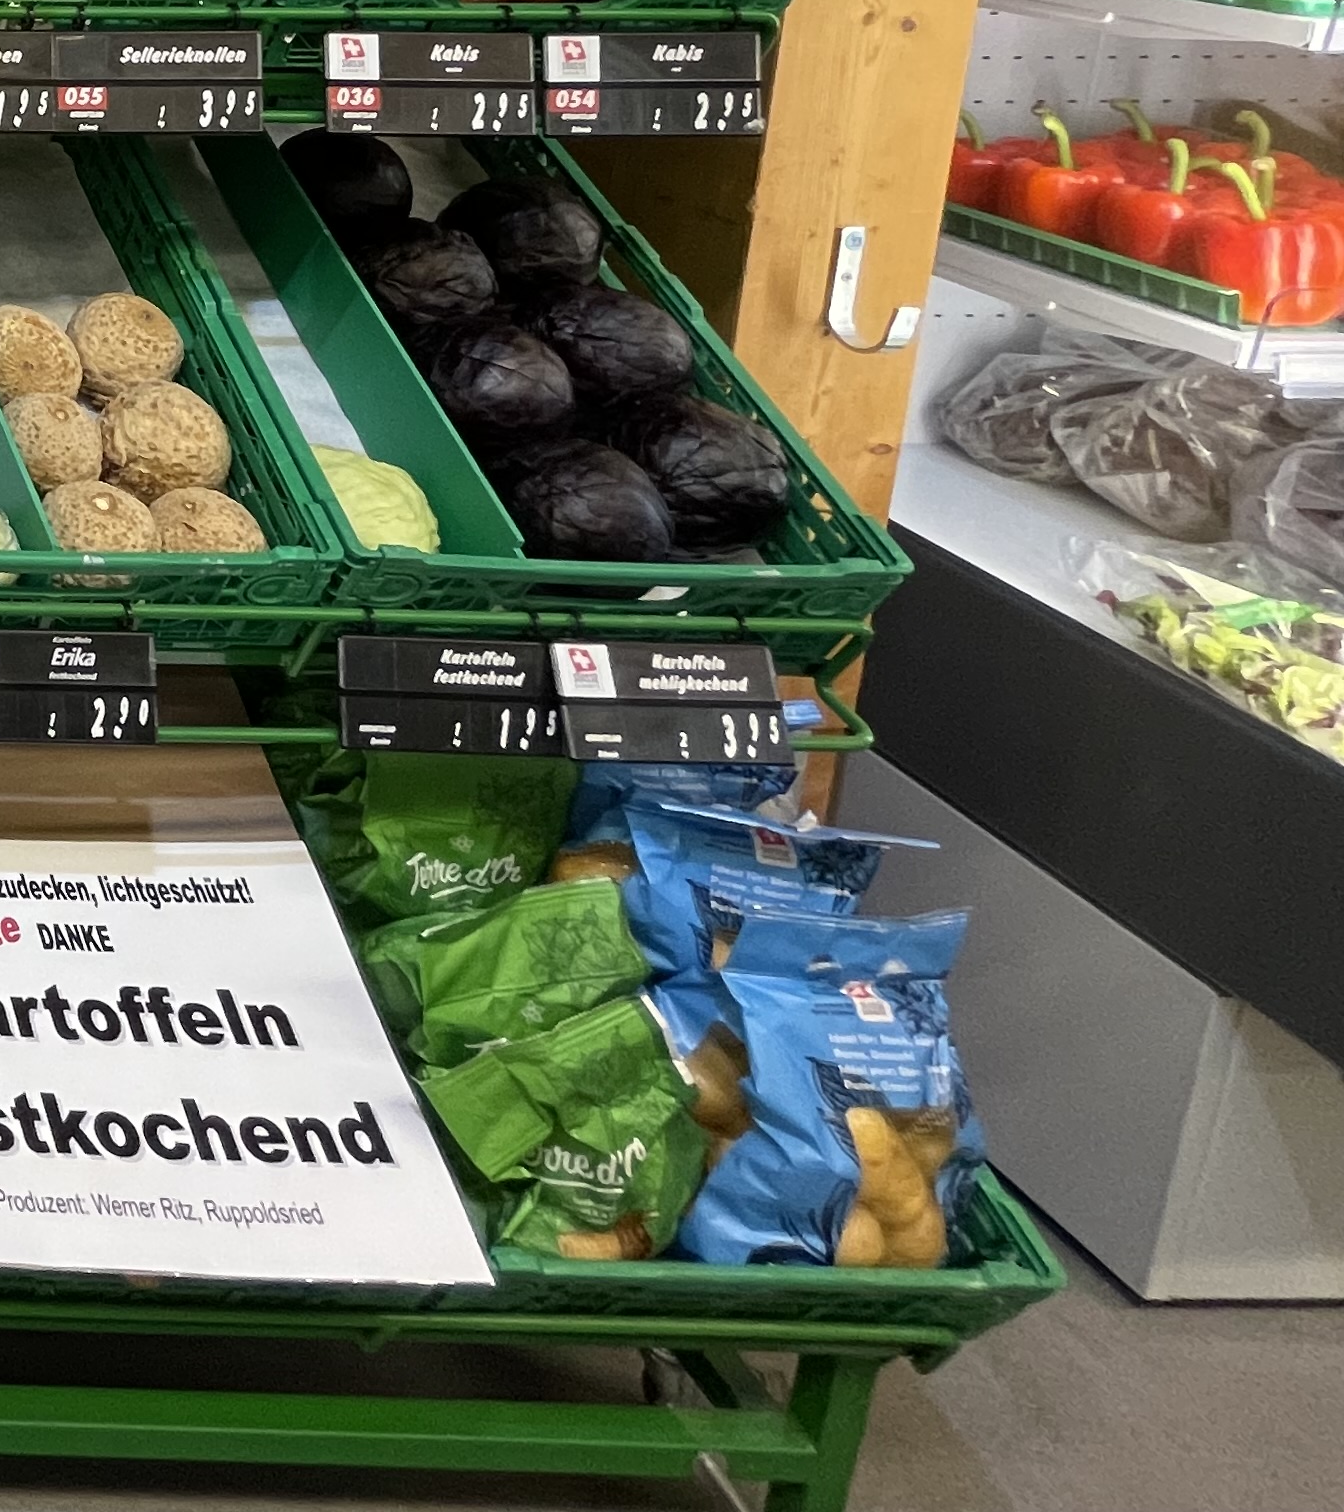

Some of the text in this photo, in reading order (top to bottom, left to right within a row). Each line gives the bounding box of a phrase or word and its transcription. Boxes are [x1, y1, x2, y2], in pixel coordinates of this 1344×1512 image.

[119, 46, 247, 65] Sellerieknollen
[430, 43, 481, 62] Kabis
[652, 43, 705, 62] Kabis
[64, 88, 105, 106] 055
[336, 88, 376, 107] 036
[555, 89, 596, 108] 054
[50, 646, 97, 668] Erika
[439, 648, 517, 669] Kartoffeln
[651, 652, 727, 672] Kartoffeln
[432, 668, 527, 690] festkochend
[638, 675, 749, 696] mehligkochend
[99, 875, 255, 910] lichtgeschützt!
[36, 921, 116, 954] DANKE
[92, 1193, 157, 1220] Werner
[159, 1197, 204, 1226] Ritz,
[204, 1199, 325, 1230] Ruppoldsried
